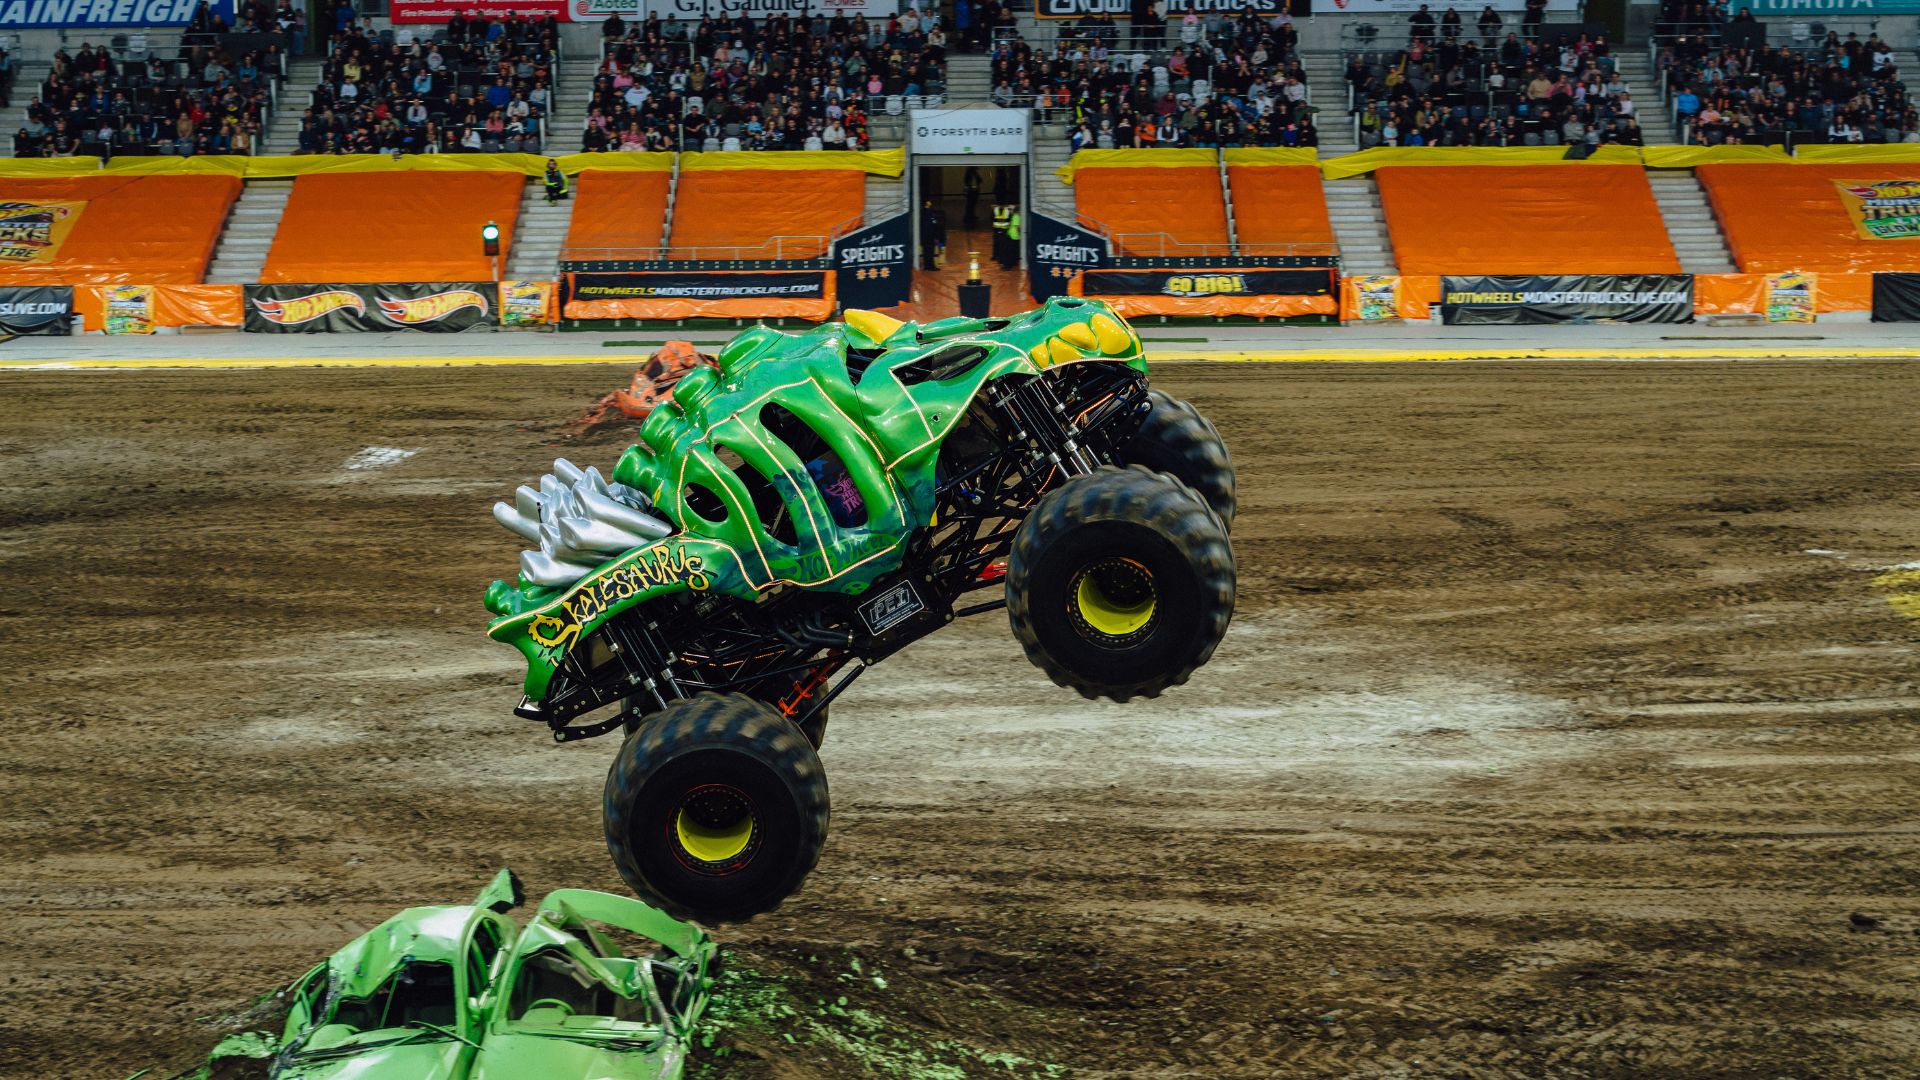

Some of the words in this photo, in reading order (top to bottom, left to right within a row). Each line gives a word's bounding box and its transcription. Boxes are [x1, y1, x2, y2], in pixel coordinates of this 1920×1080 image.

[0, 0, 220, 23] AINFREIGH
[932, 128, 988, 136] FORSYTH
[990, 127, 1023, 136] BARR
[579, 284, 819, 296] HOTWHEELSMONSTERTRUCKSLIVE.COM
[1169, 277, 1192, 292] GO
[1194, 276, 1243, 293] BIG!
[1446, 291, 1688, 305] HOTWHEELSMONSTERTRUCKSLIVE.COM
[281, 300, 313, 322] HOT
[403, 300, 435, 322] HOT
